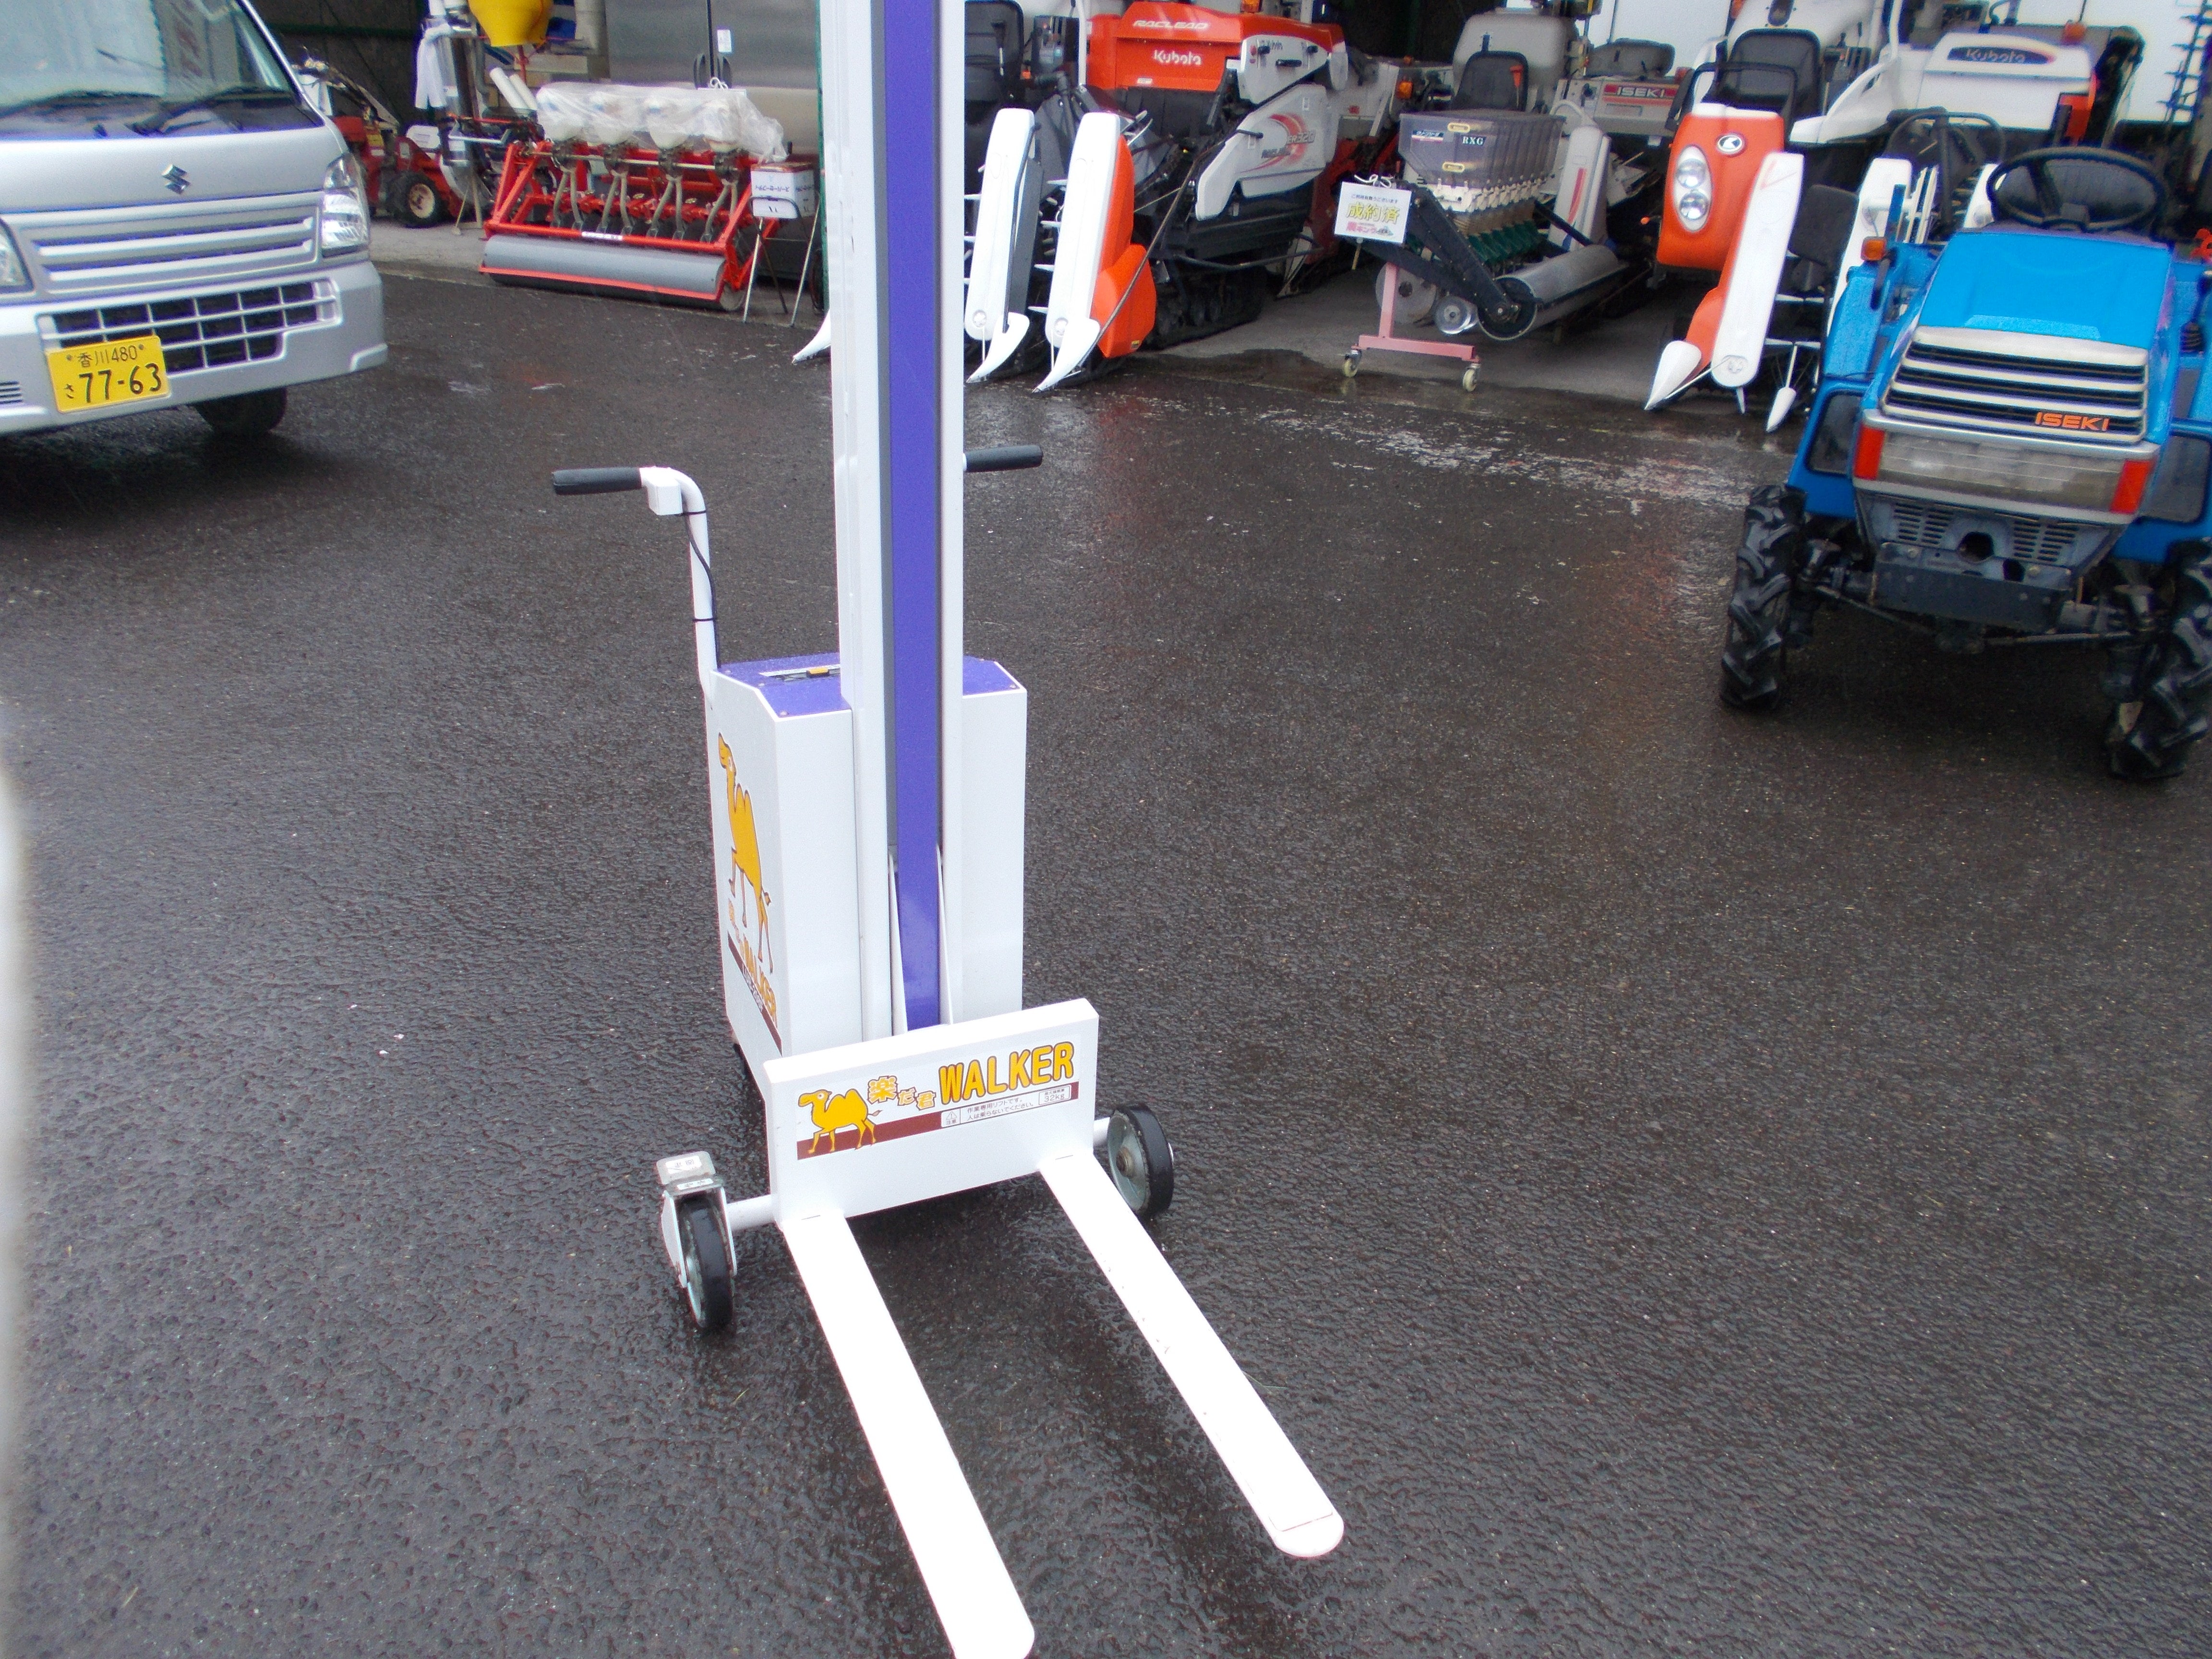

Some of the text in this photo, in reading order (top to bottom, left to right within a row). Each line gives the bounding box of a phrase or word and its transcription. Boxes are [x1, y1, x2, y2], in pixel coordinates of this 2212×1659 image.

[1153, 49, 1202, 66] Kubota
[1966, 48, 2026, 64] Kubota
[1617, 86, 1665, 98] ISEKI
[1463, 136, 1484, 146] RXG
[1346, 201, 1401, 225] 成約済
[79, 362, 162, 404] 77-63
[2034, 411, 2110, 432] ISEKI
[867, 1041, 1075, 1111] 楽だ君 WALKER
[967, 1097, 1022, 1114] 作業専用リフトです。
[1044, 1094, 1065, 1103] 32kg
[967, 1101, 1034, 1122] 人は乗らないでください。
